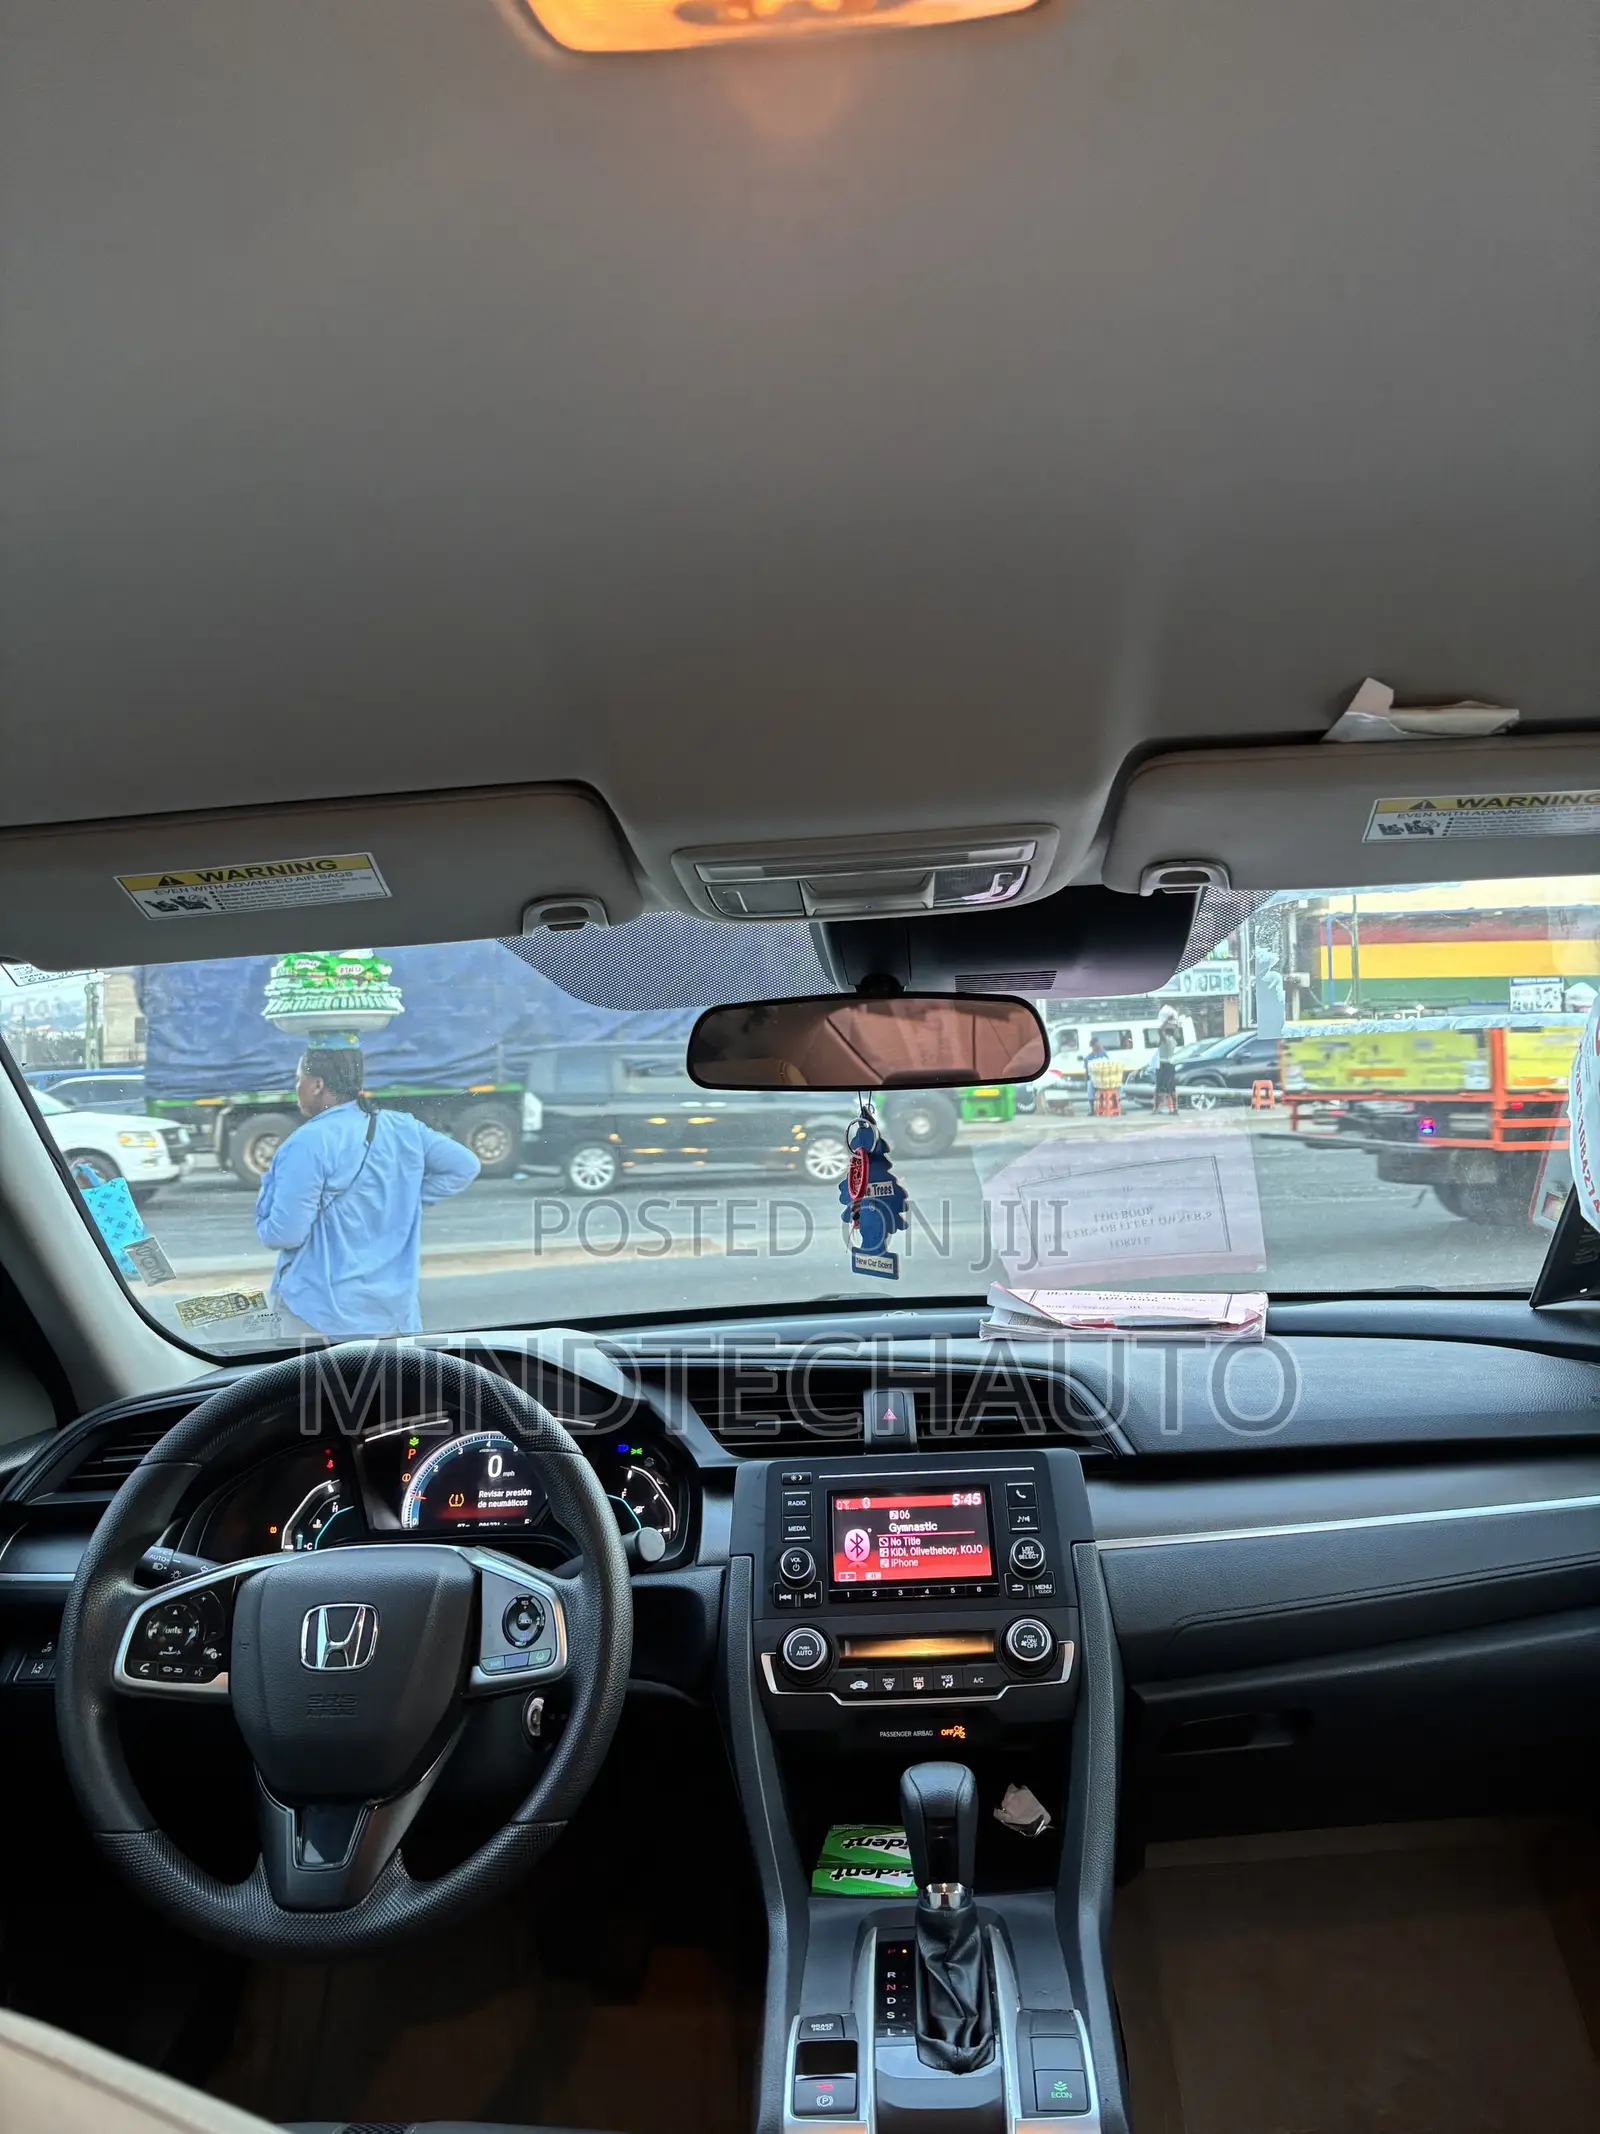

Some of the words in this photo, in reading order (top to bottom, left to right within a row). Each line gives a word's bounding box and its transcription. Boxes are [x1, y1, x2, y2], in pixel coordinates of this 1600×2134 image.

[1456, 793, 1600, 809] WARNING
[1397, 811, 1433, 819] EVEN
[1436, 809, 1469, 818] WITH
[1469, 806, 1547, 817] ADVANCED
[196, 860, 337, 883] WARNING
[154, 885, 188, 896] EVEN
[190, 882, 217, 893] WITH
[218, 876, 296, 891] ADVANCED
[296, 874, 316, 885] AIR
[318, 871, 354, 882] BAGS
[872, 1184, 893, 1196] Trees
[856, 1257, 867, 1266] New
[868, 1258, 878, 1268] Car
[878, 1260, 893, 1270] Scent
[408, 1448, 417, 1459] P
[487, 1454, 503, 1478] 0
[502, 1470, 516, 1478] mph
[478, 1489, 505, 1498] Revisar
[505, 1488, 532, 1498] presión
[477, 1500, 487, 1508] de
[488, 1499, 528, 1508] neumáticos
[951, 1493, 982, 1506] 5:45
[899, 1510, 911, 1520] 06
[888, 1522, 938, 1534] Gymnastic
[890, 1538, 902, 1546] No
[903, 1537, 921, 1546] Title
[960, 1544, 983, 1554] KOJO
[149, 1553, 167, 1562] AUTO
[891, 1559, 919, 1567] iPhone
